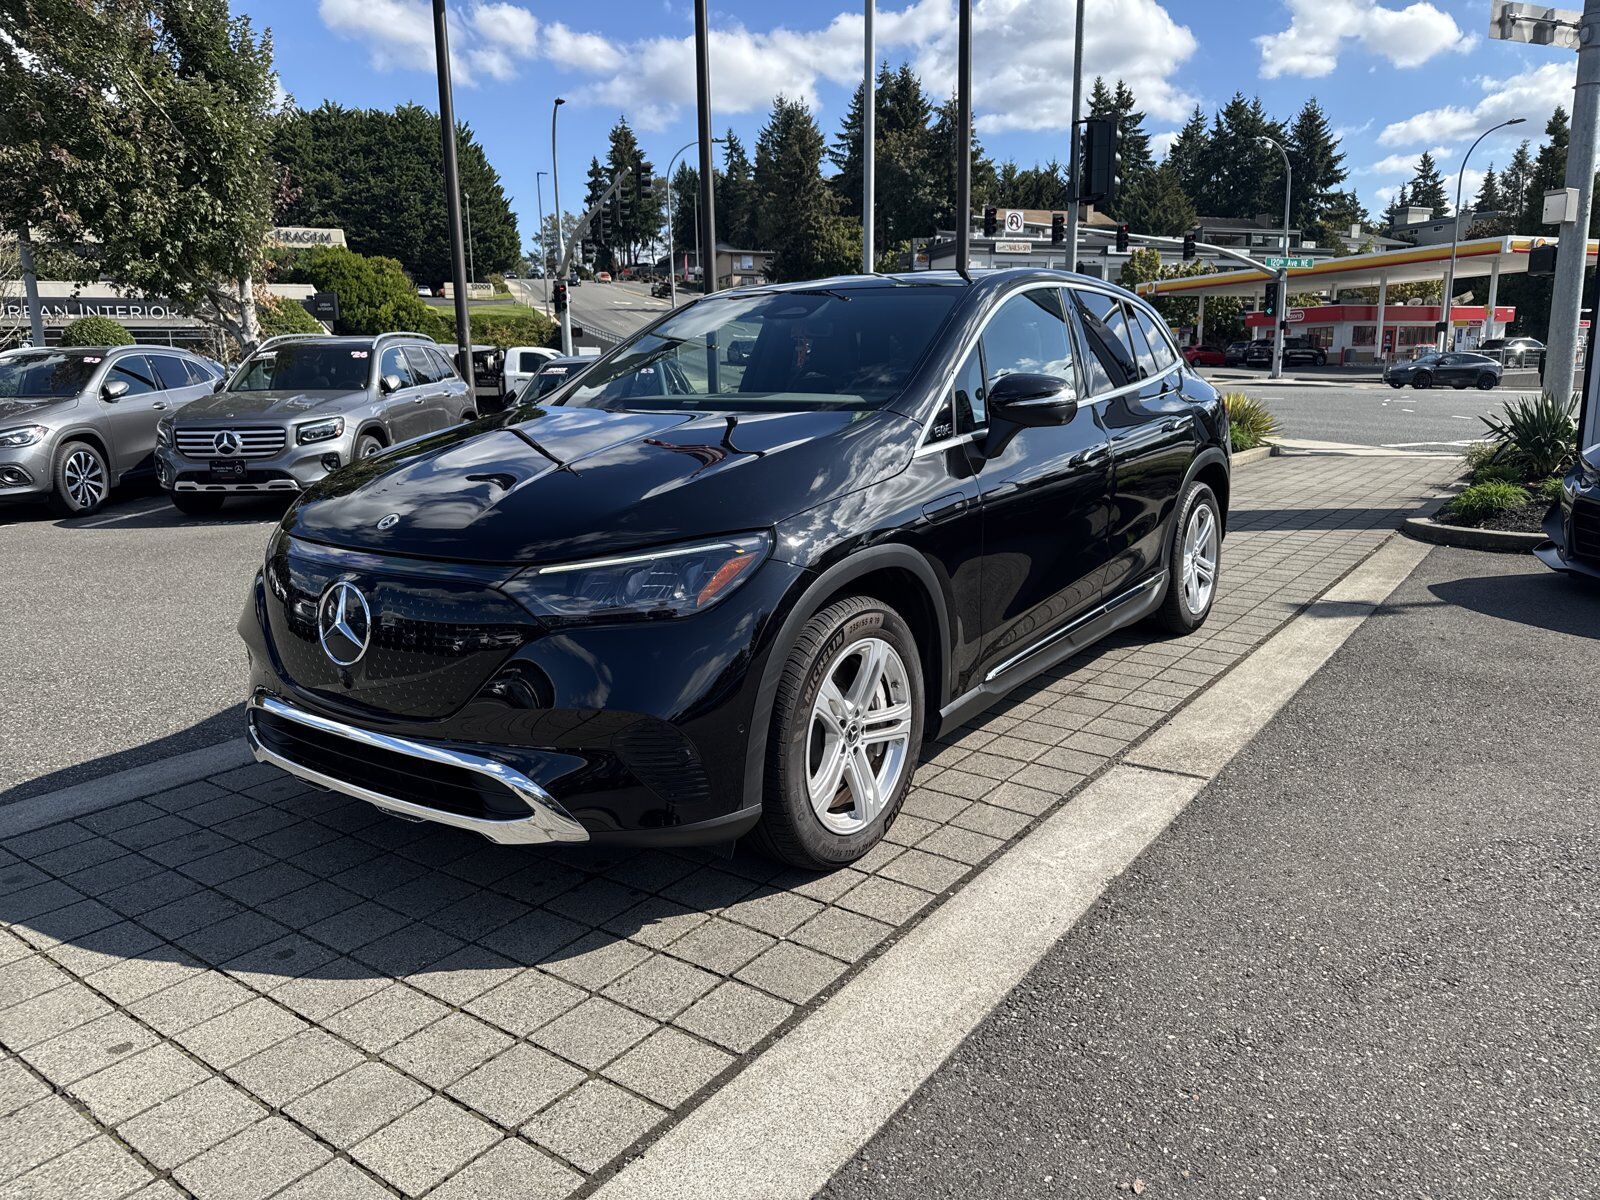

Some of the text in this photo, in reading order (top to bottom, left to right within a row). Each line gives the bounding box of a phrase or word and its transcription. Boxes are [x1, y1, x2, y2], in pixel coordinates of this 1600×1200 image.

[271, 229, 332, 243] ERAGEM
[1287, 259, 1297, 267] Ave
[1300, 259, 1309, 267] NE
[868, 616, 874, 625] R
[803, 628, 845, 704] MICHELIN
